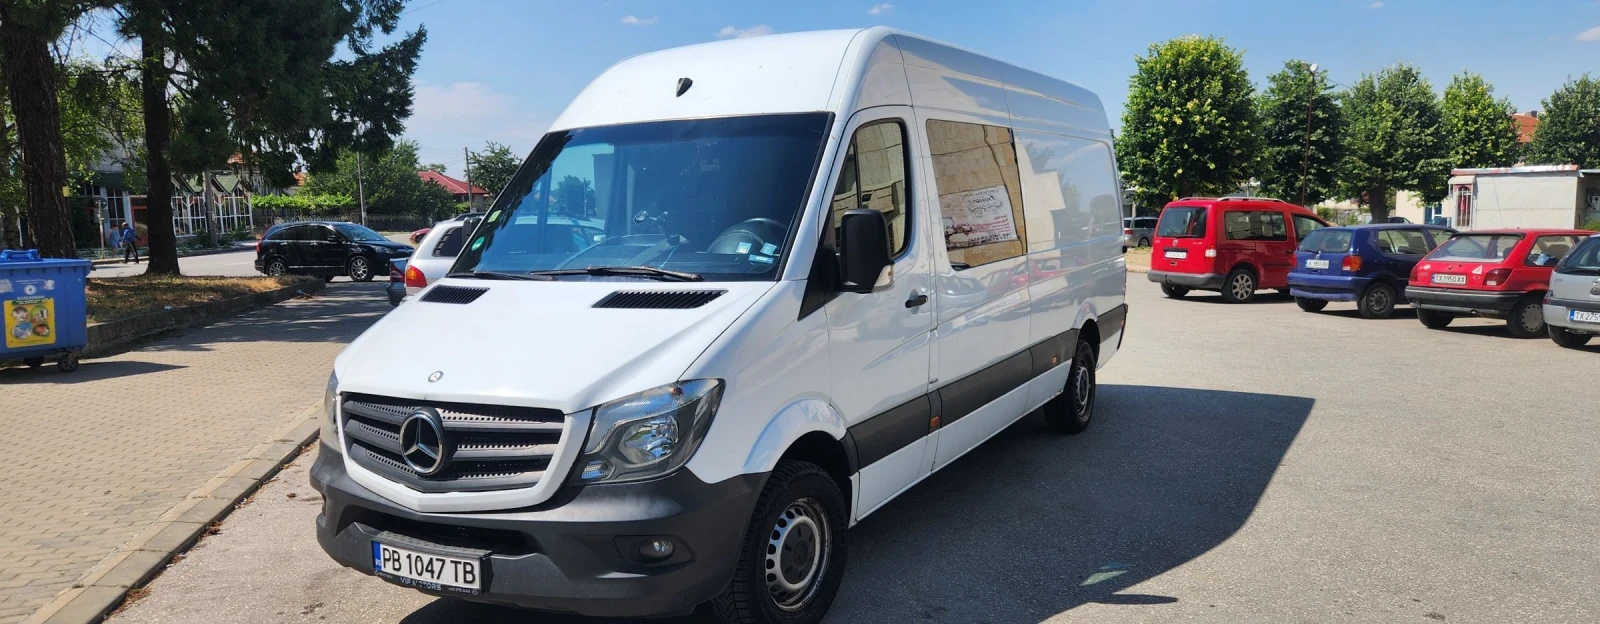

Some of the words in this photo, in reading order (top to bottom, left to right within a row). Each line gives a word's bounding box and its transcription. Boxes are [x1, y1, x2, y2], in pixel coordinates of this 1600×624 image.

[1576, 311, 1584, 320] TX
[382, 547, 402, 572] PB
[406, 553, 446, 580] 1047
[450, 560, 476, 585] TB
